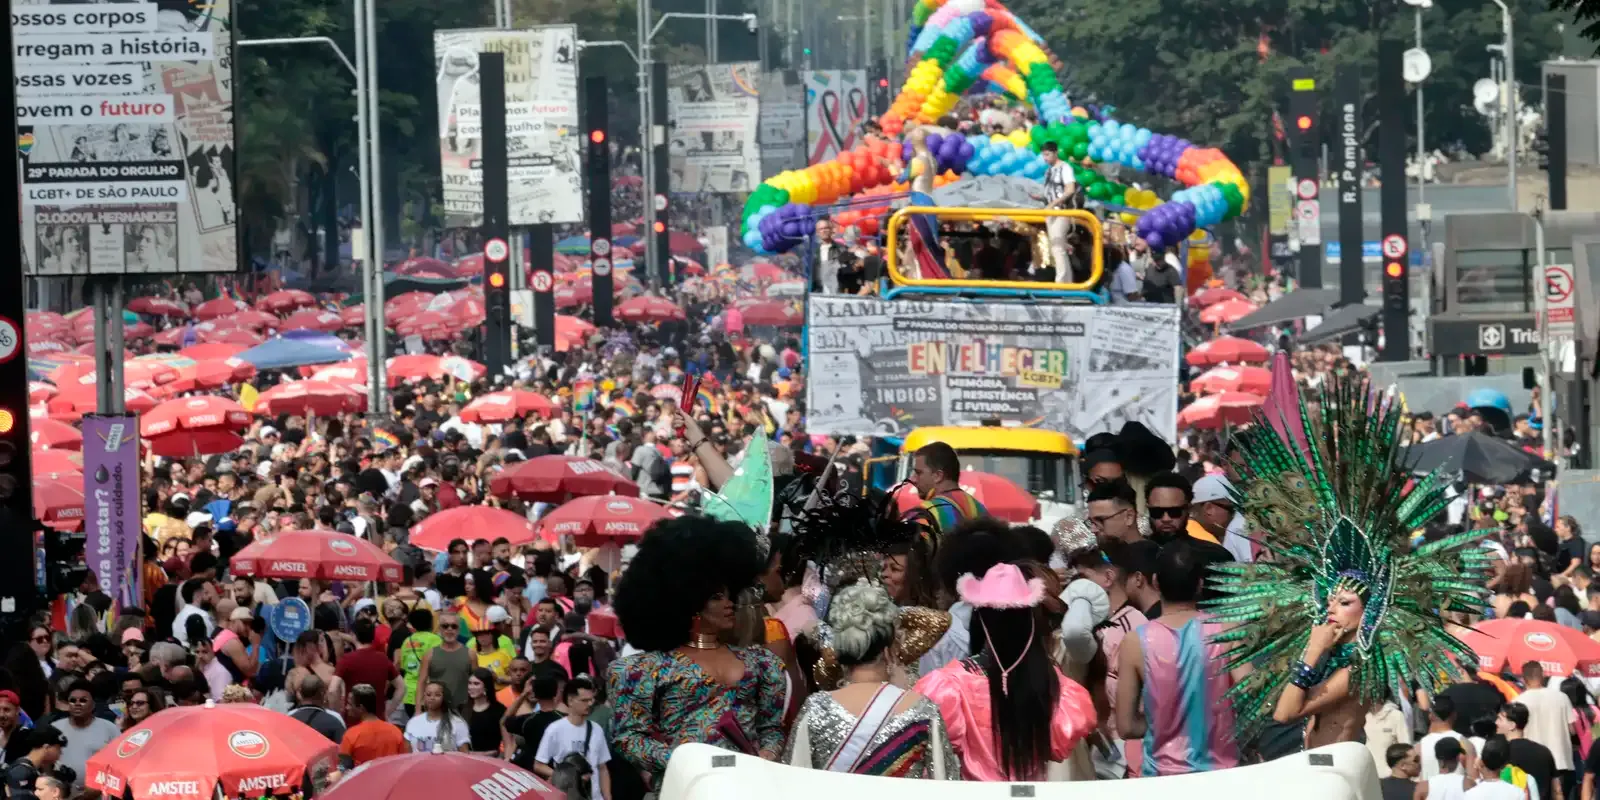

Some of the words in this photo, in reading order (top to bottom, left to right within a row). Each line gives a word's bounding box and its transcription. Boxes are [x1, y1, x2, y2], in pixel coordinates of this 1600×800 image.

[12, 13, 67, 26] ossos
[73, 11, 146, 28] corpos
[17, 43, 94, 60] rregam
[102, 44, 113, 56] a
[120, 36, 207, 57] história,
[15, 75, 66, 87] ssas
[72, 73, 133, 86] vozes
[17, 104, 73, 118] ovem
[80, 104, 93, 117] o
[100, 100, 166, 116] futuro
[532, 104, 568, 113] futuro
[1341, 103, 1359, 182] Pamplona
[49, 167, 98, 178] PARADA
[100, 166, 118, 176] DO
[120, 165, 179, 176] ORGULHO
[29, 189, 72, 200] LGBT+
[76, 188, 95, 199] DE
[98, 185, 128, 198] SÃO
[131, 186, 179, 198] PAULO
[1342, 185, 1357, 203] R.
[35, 212, 98, 224] CLODOVIL
[910, 321, 944, 329] PARADA
[945, 322, 957, 330] DO
[959, 322, 998, 331] ORGULHO
[1510, 328, 1541, 344] Tria
[910, 340, 1067, 376] ENVELHECER
[949, 376, 1006, 389] MEMÓRIA,
[1023, 372, 1060, 384] LGBT+
[962, 388, 1036, 401] RESISTÊNCIA
[955, 401, 963, 411] E
[188, 414, 219, 425] AMSTEL
[112, 461, 124, 517] cuidado.
[56, 507, 84, 519] AMSTEL
[95, 488, 111, 555] testar?
[554, 521, 582, 531] AMSTEL
[605, 521, 640, 532] AMSTEL
[271, 560, 308, 573] AMSTEL
[333, 564, 368, 577] AMSTEL
[1540, 661, 1563, 673] STEL
[149, 780, 199, 796] AMSTEL
[237, 773, 288, 792] AMSTEL
